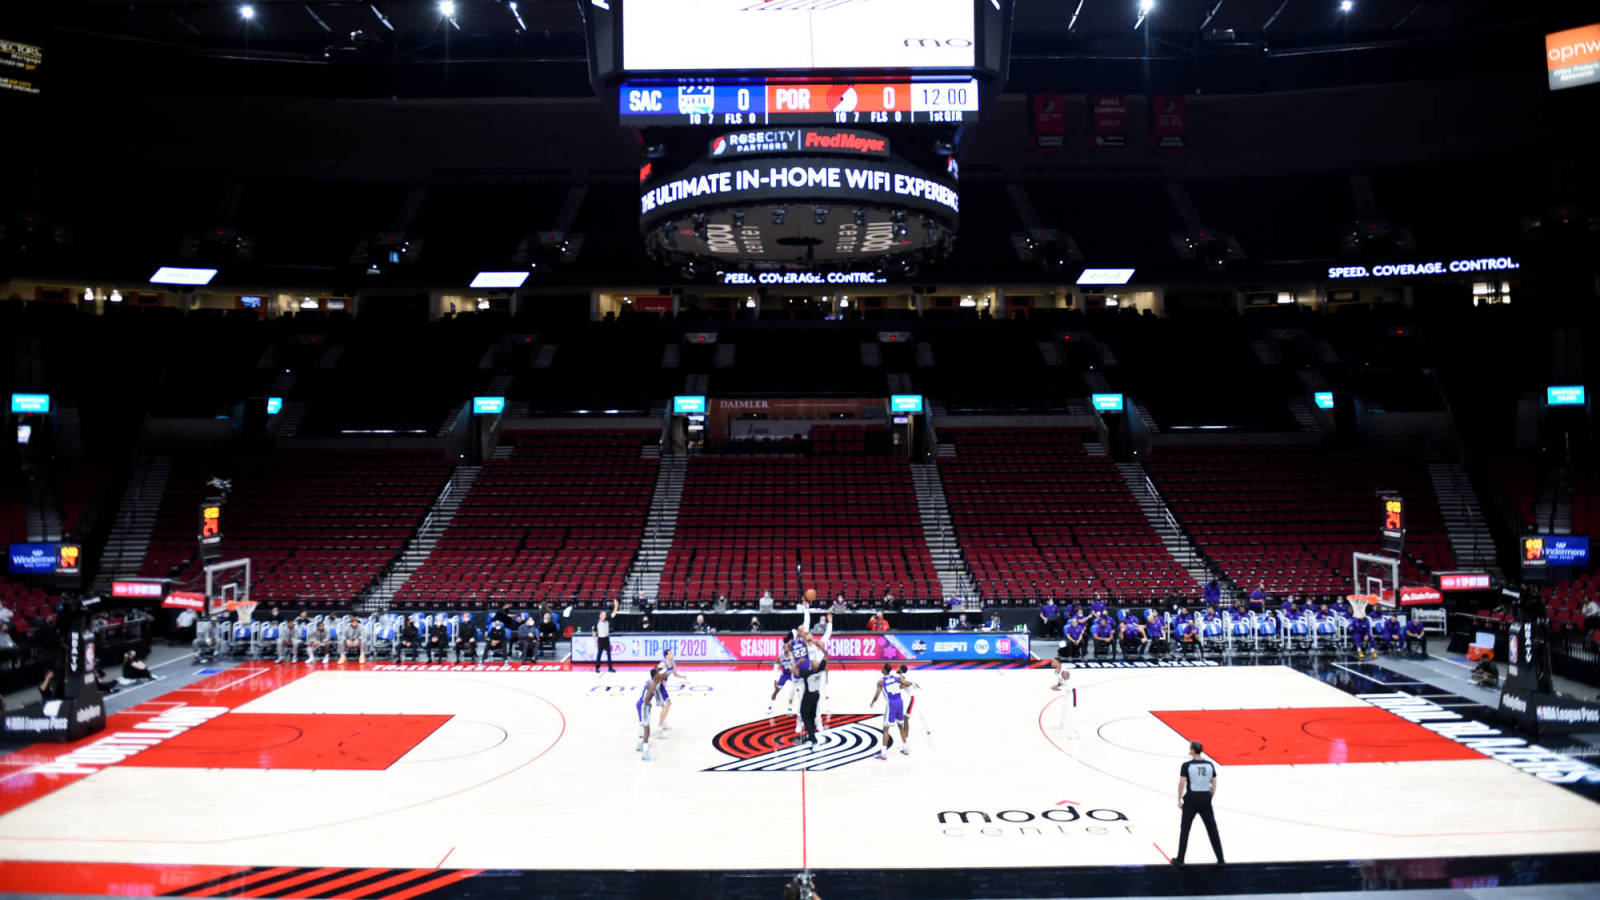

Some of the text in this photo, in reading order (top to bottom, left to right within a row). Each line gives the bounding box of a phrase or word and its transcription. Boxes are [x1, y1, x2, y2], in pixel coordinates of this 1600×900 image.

[629, 90, 662, 111] SAC
[738, 88, 749, 110] 0
[775, 86, 895, 109] POR 0
[922, 88, 967, 105] 12:00
[725, 113, 742, 124] FLS
[749, 113, 756, 124] 0
[871, 112, 888, 122] FLS
[895, 112, 902, 122] 0
[737, 142, 788, 152] PARTNERS
[656, 171, 732, 206] ULTIMATE
[736, 166, 841, 190] IN-HOME
[844, 168, 890, 192] WIFI
[1328, 257, 1519, 278] SPEED. COVERAGE. CONTROL.
[720, 400, 769, 409] DAIMLER
[644, 639, 707, 657] TIP-OFF 2020
[740, 638, 776, 657] SEASON
[863, 638, 876, 657] 22
[793, 647, 808, 658] 22
[912, 640, 927, 651] abc
[934, 642, 968, 652] ESPN
[1556, 706, 1581, 724] League
[1582, 706, 1600, 722] Pass
[25, 716, 49, 733] League
[50, 716, 68, 730] Pass
[937, 805, 1129, 824] moda
